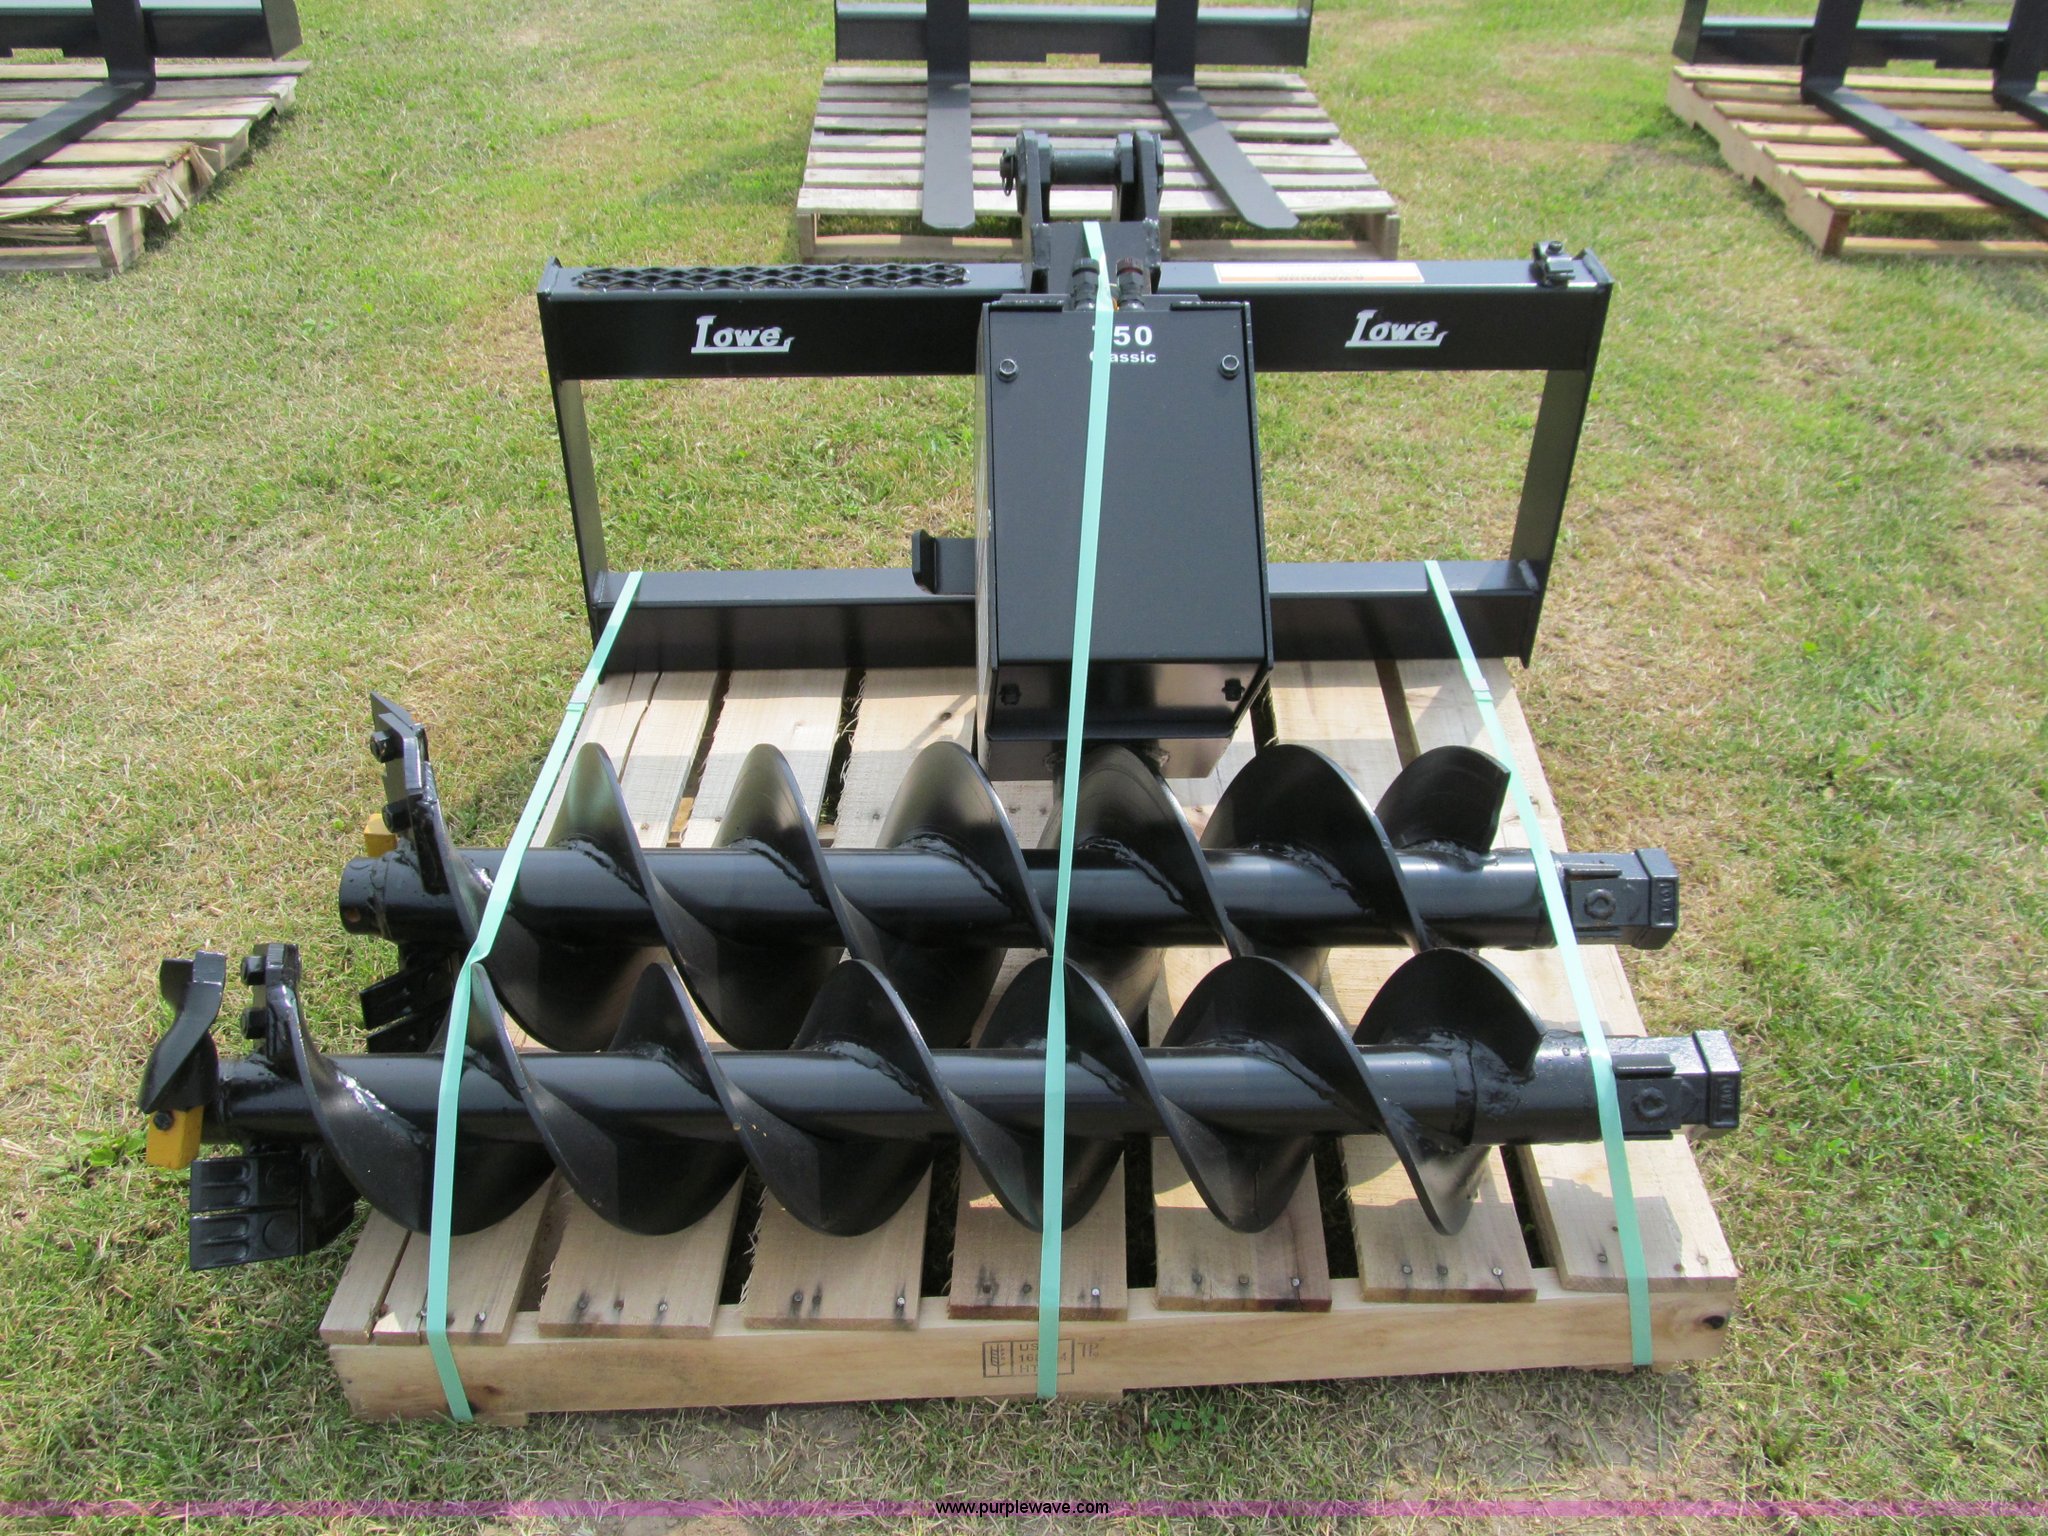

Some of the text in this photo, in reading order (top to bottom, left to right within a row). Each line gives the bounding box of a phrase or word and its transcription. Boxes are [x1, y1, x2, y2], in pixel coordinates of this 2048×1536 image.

[690, 314, 795, 353] Lowe
[1091, 324, 1153, 346] 50
[1344, 309, 1448, 348] Lowe
[1089, 350, 1157, 363] assic
